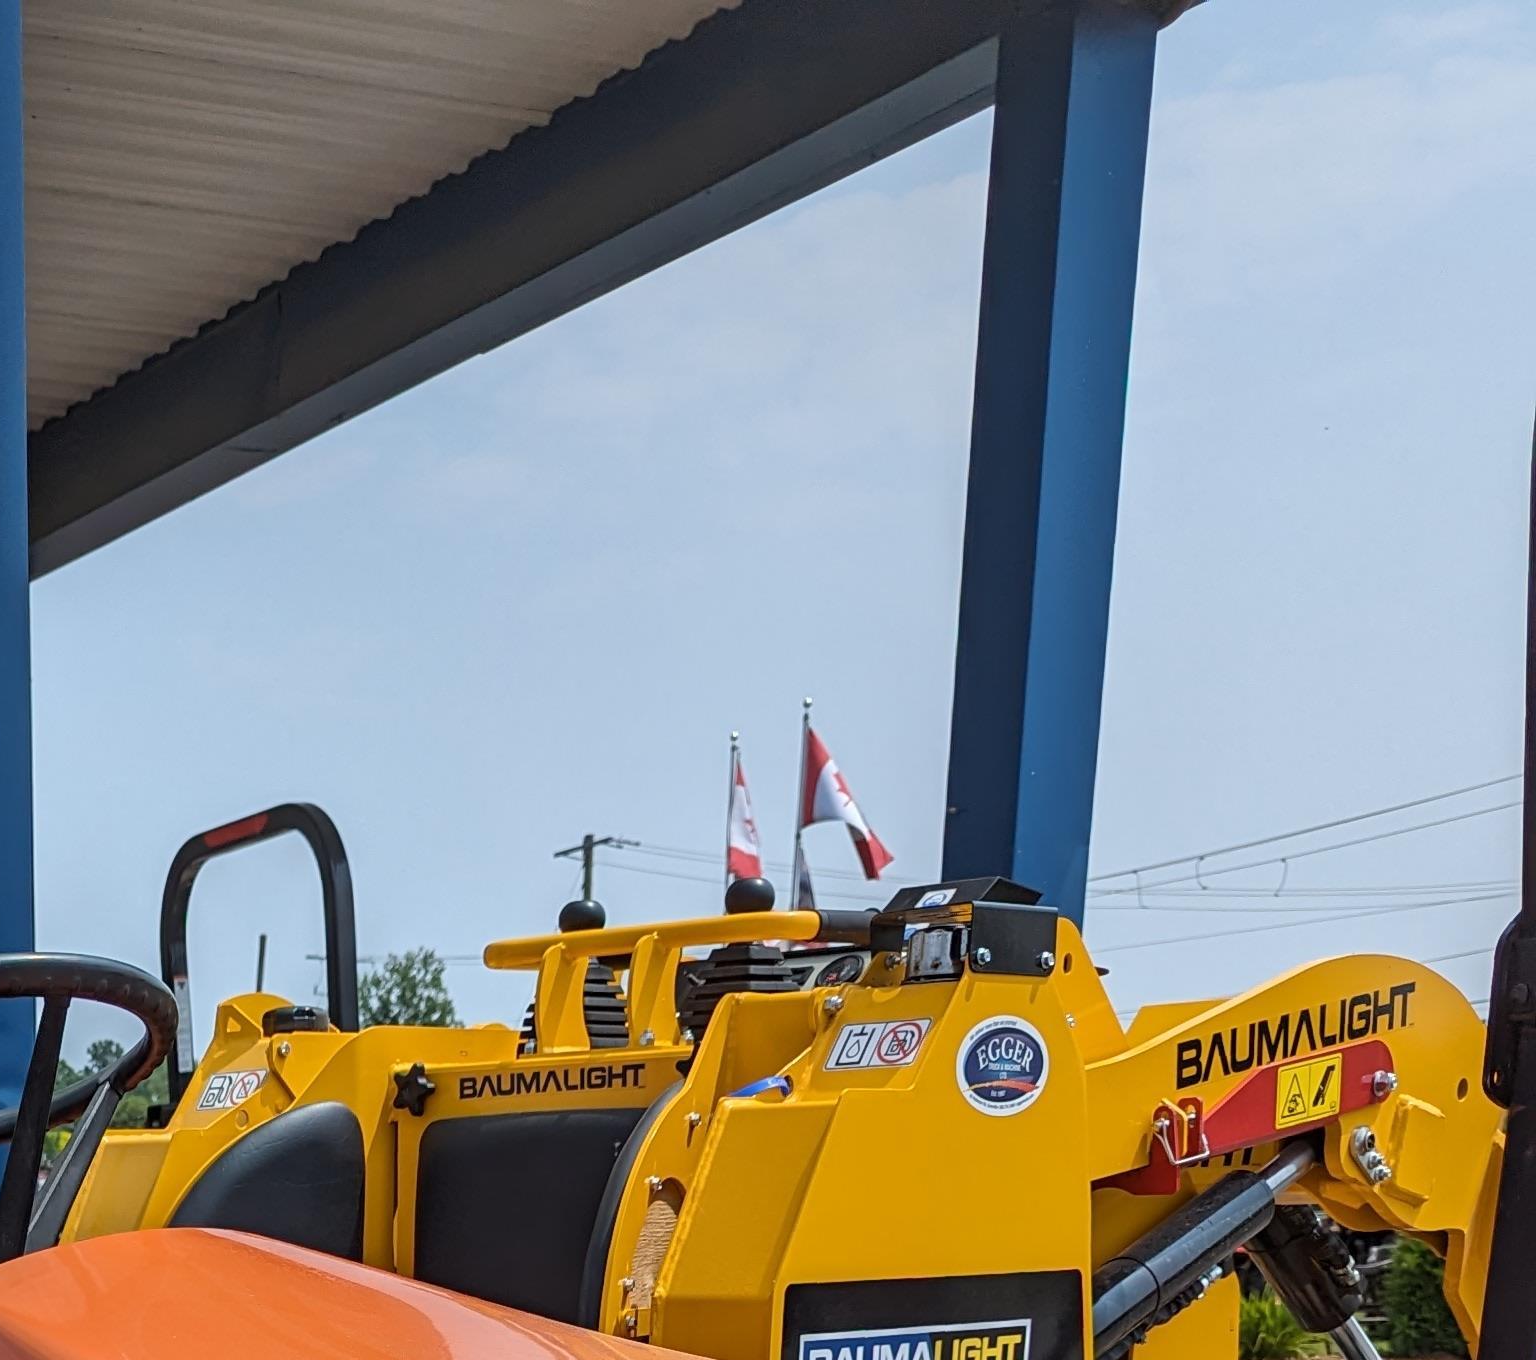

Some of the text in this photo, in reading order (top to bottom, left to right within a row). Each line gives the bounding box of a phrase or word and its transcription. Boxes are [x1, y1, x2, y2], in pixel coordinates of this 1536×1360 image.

[1176, 982, 1416, 1090] BAUMALIGHT
[976, 1037, 1034, 1072] EGGER
[459, 1063, 645, 1099] BAUMALIGHT
